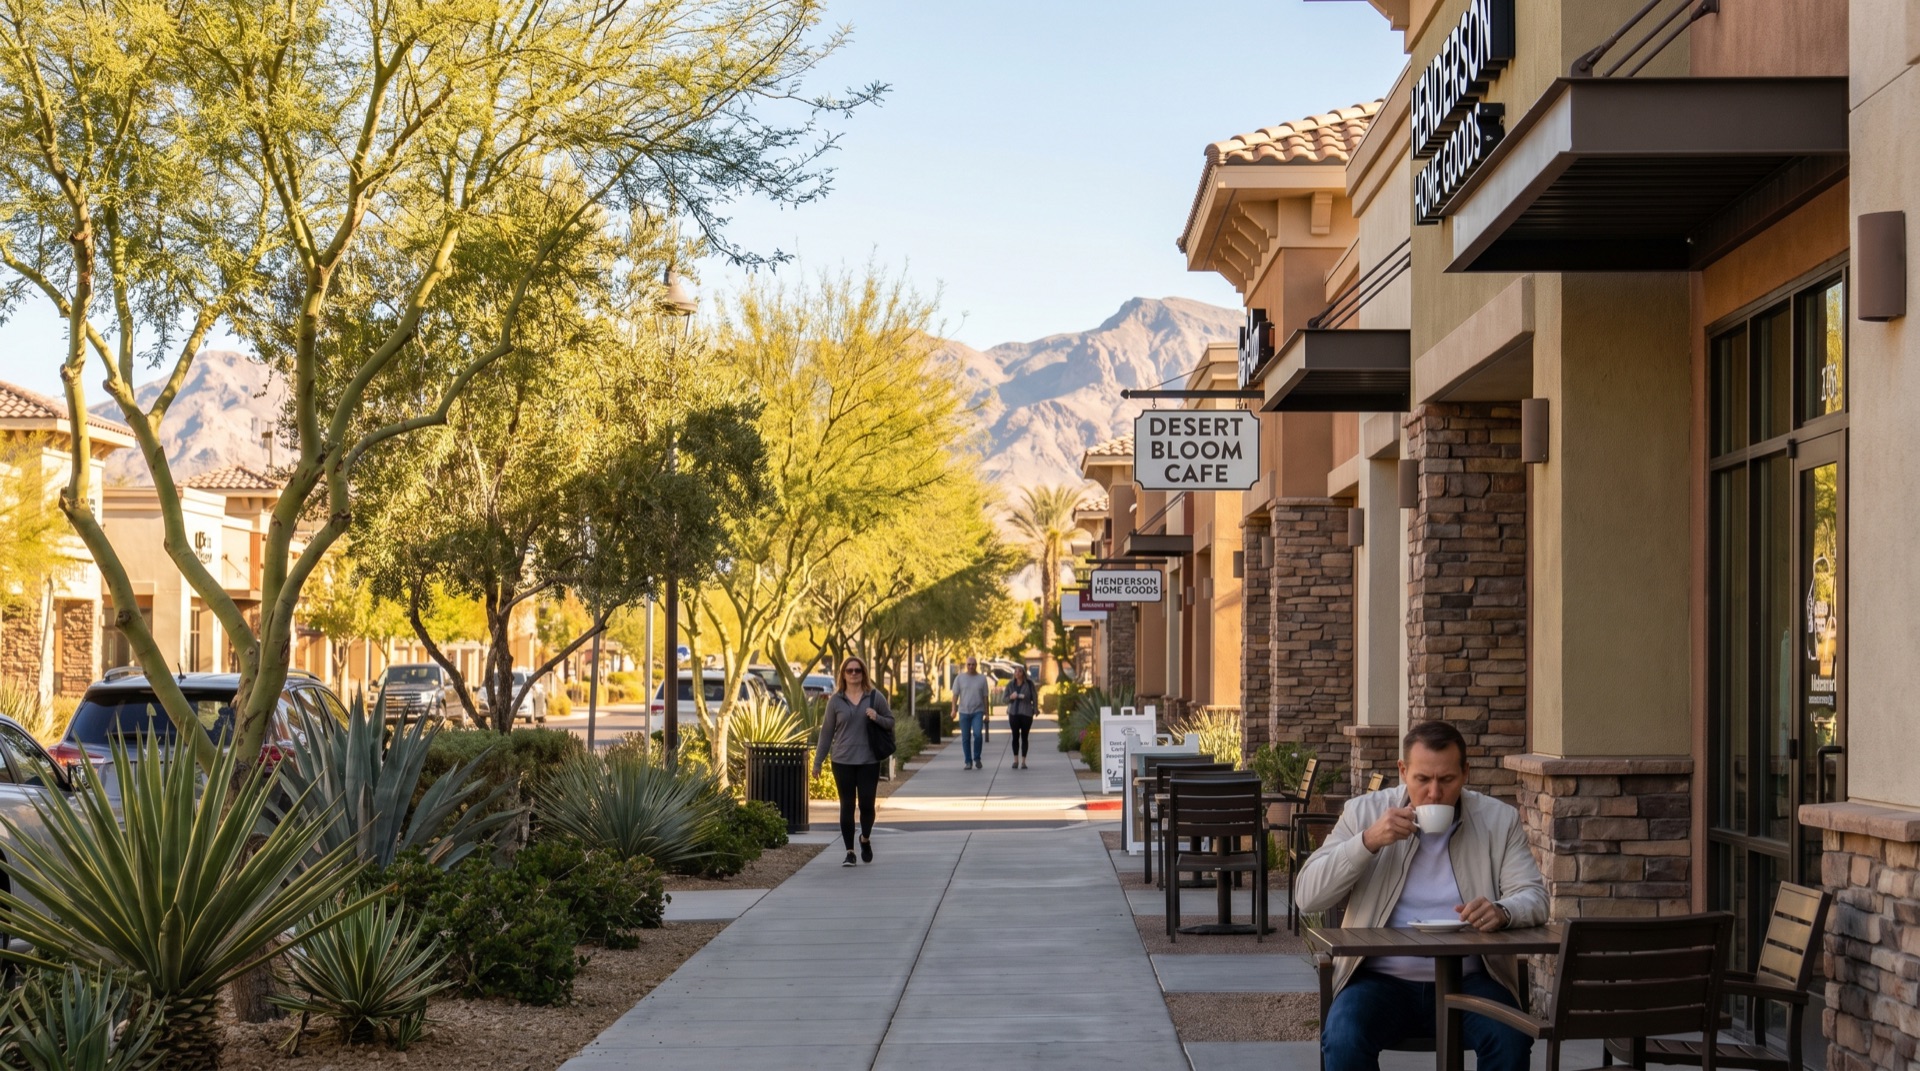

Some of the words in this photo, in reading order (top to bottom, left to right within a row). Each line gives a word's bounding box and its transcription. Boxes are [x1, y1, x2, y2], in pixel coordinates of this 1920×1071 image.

[1411, 0, 1491, 160] HENDERSON
[1414, 149, 1441, 224] HOME
[1443, 102, 1481, 194] GOODS
[1150, 417, 1243, 437] DESERT
[1151, 440, 1243, 460] BLOOM
[1164, 463, 1228, 483] CAFE
[1094, 586, 1122, 594] HOME
[1124, 586, 1159, 595] GOODS
[1096, 577, 1157, 586] HENDERSON
